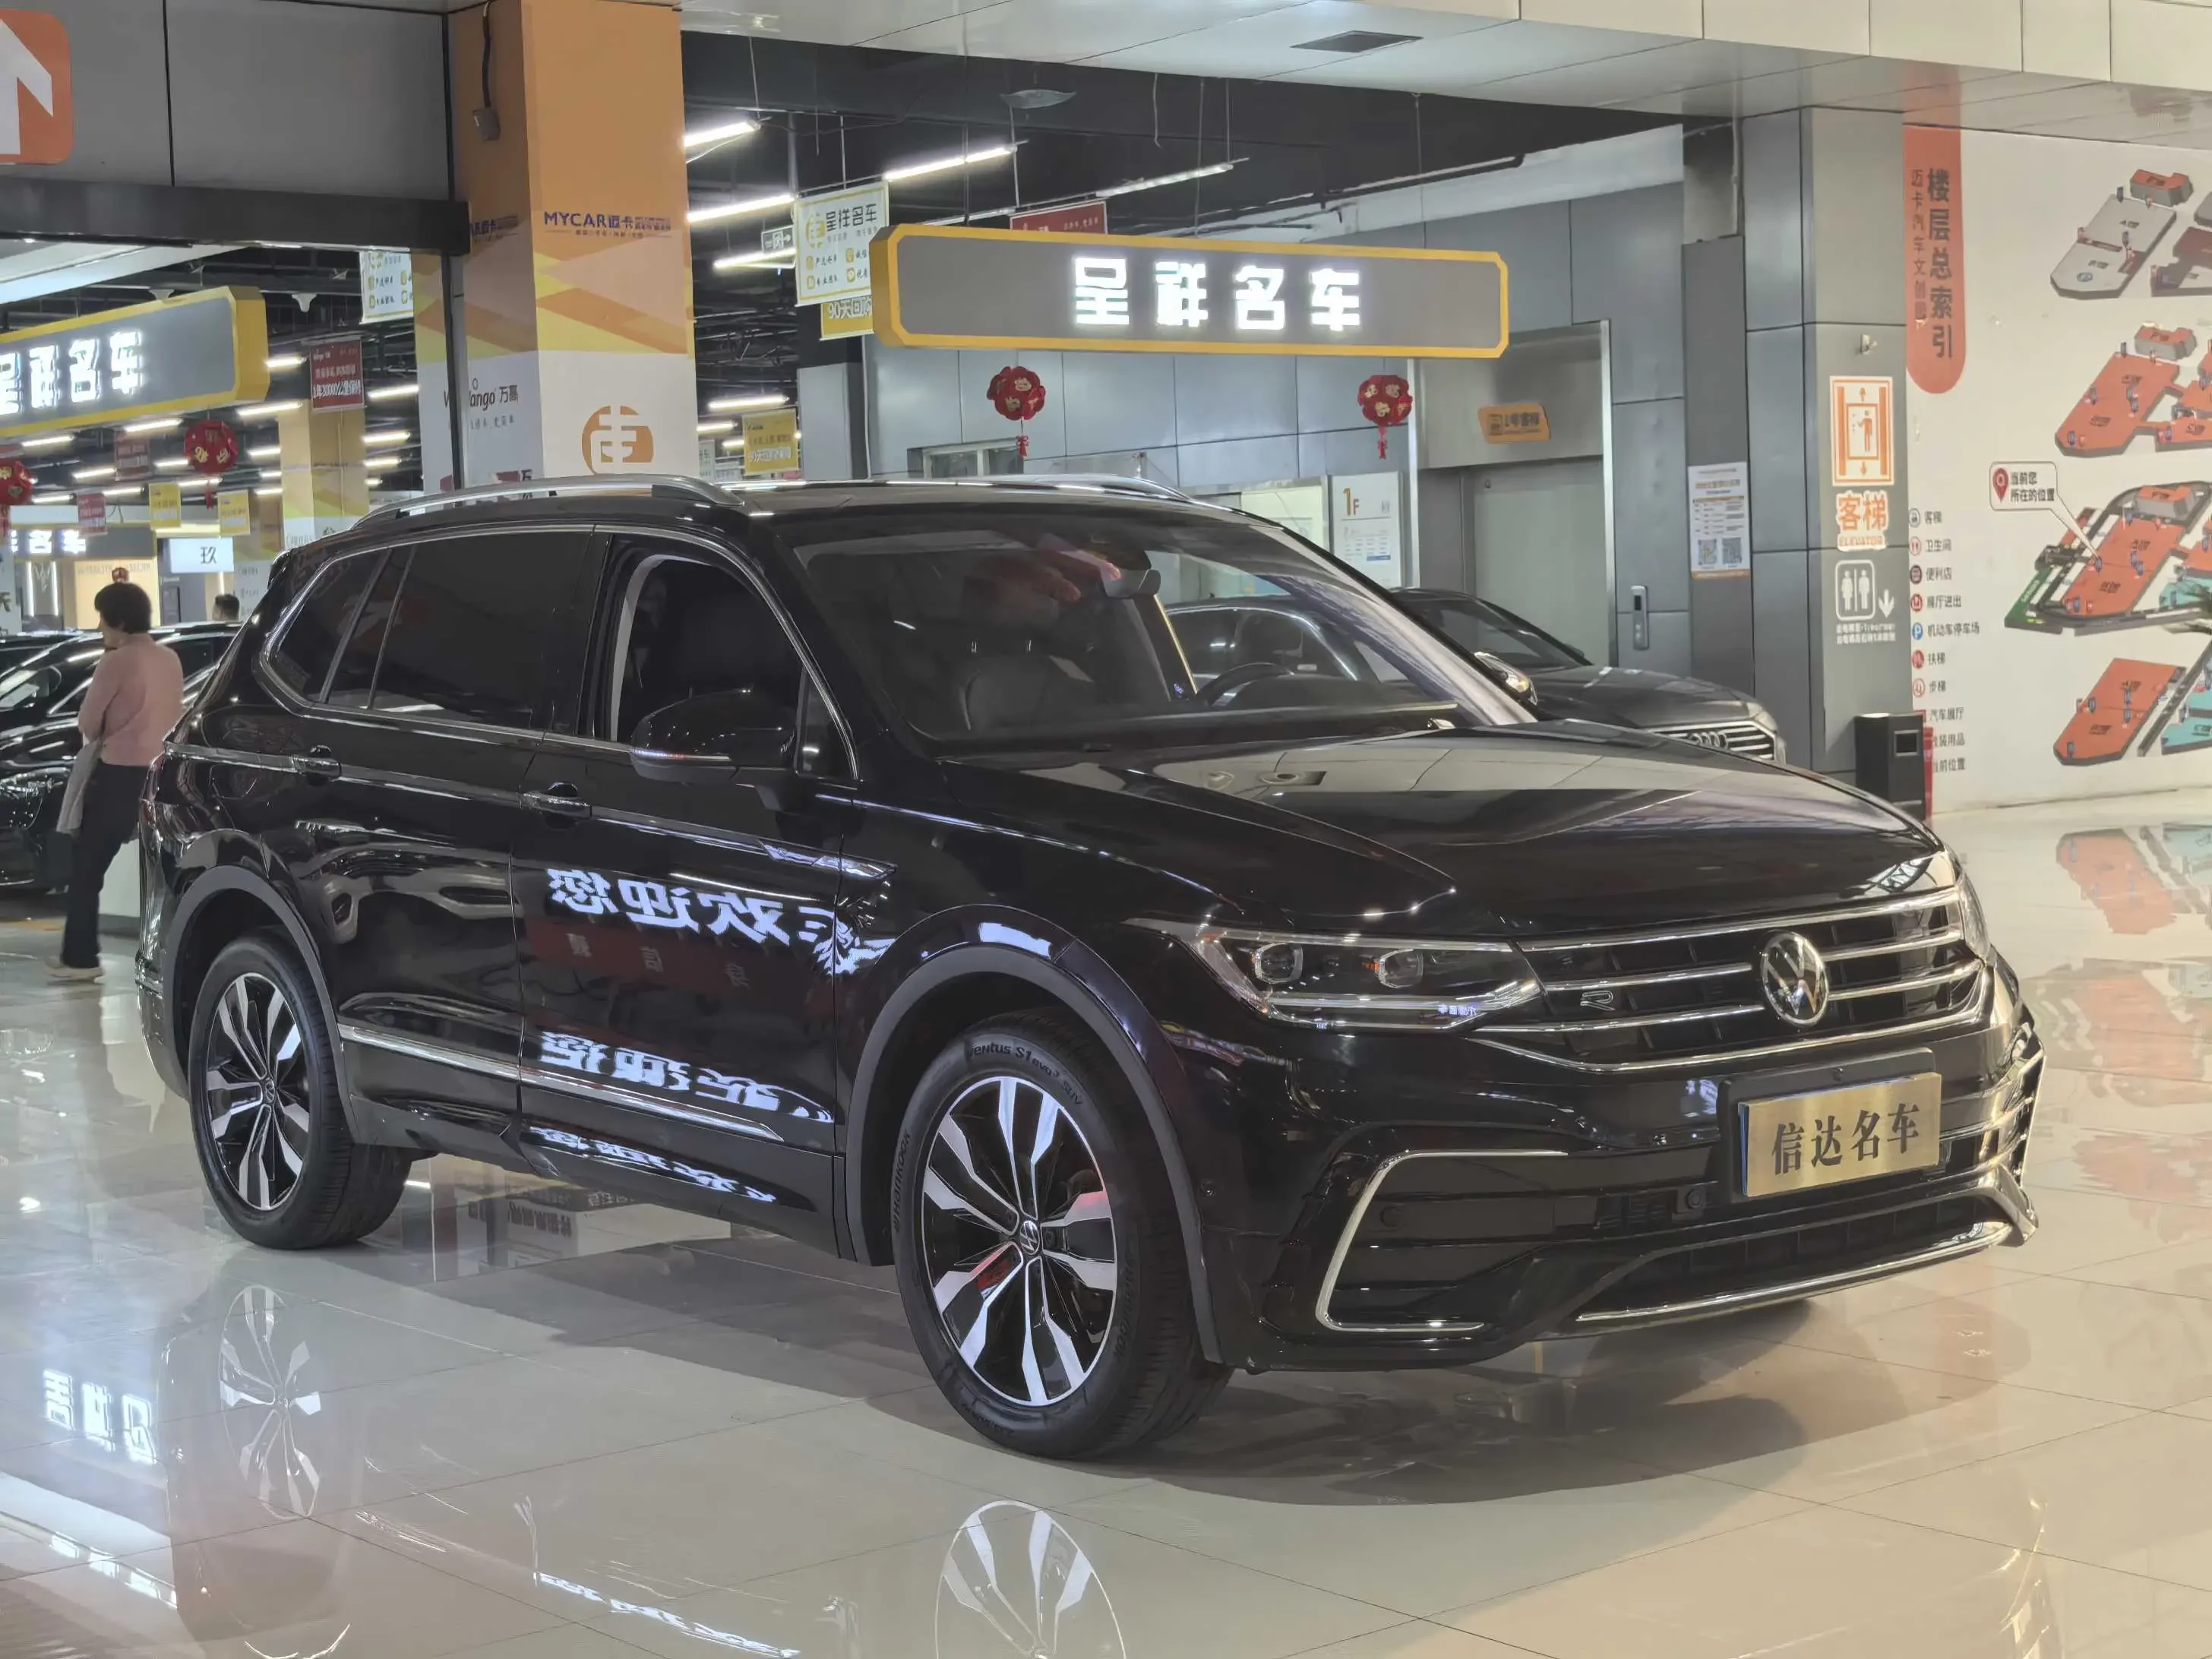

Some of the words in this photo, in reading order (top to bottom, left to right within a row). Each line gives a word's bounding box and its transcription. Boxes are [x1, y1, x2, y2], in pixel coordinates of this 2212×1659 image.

[1927, 168, 1952, 359] 楼层总索引
[1075, 257, 1360, 332] 呈祥名车
[1838, 494, 1887, 531] 客梯
[1926, 539, 1951, 552] 卫生间
[1926, 567, 1952, 581] 便利店
[1771, 1102, 1920, 1177] 信达名车
